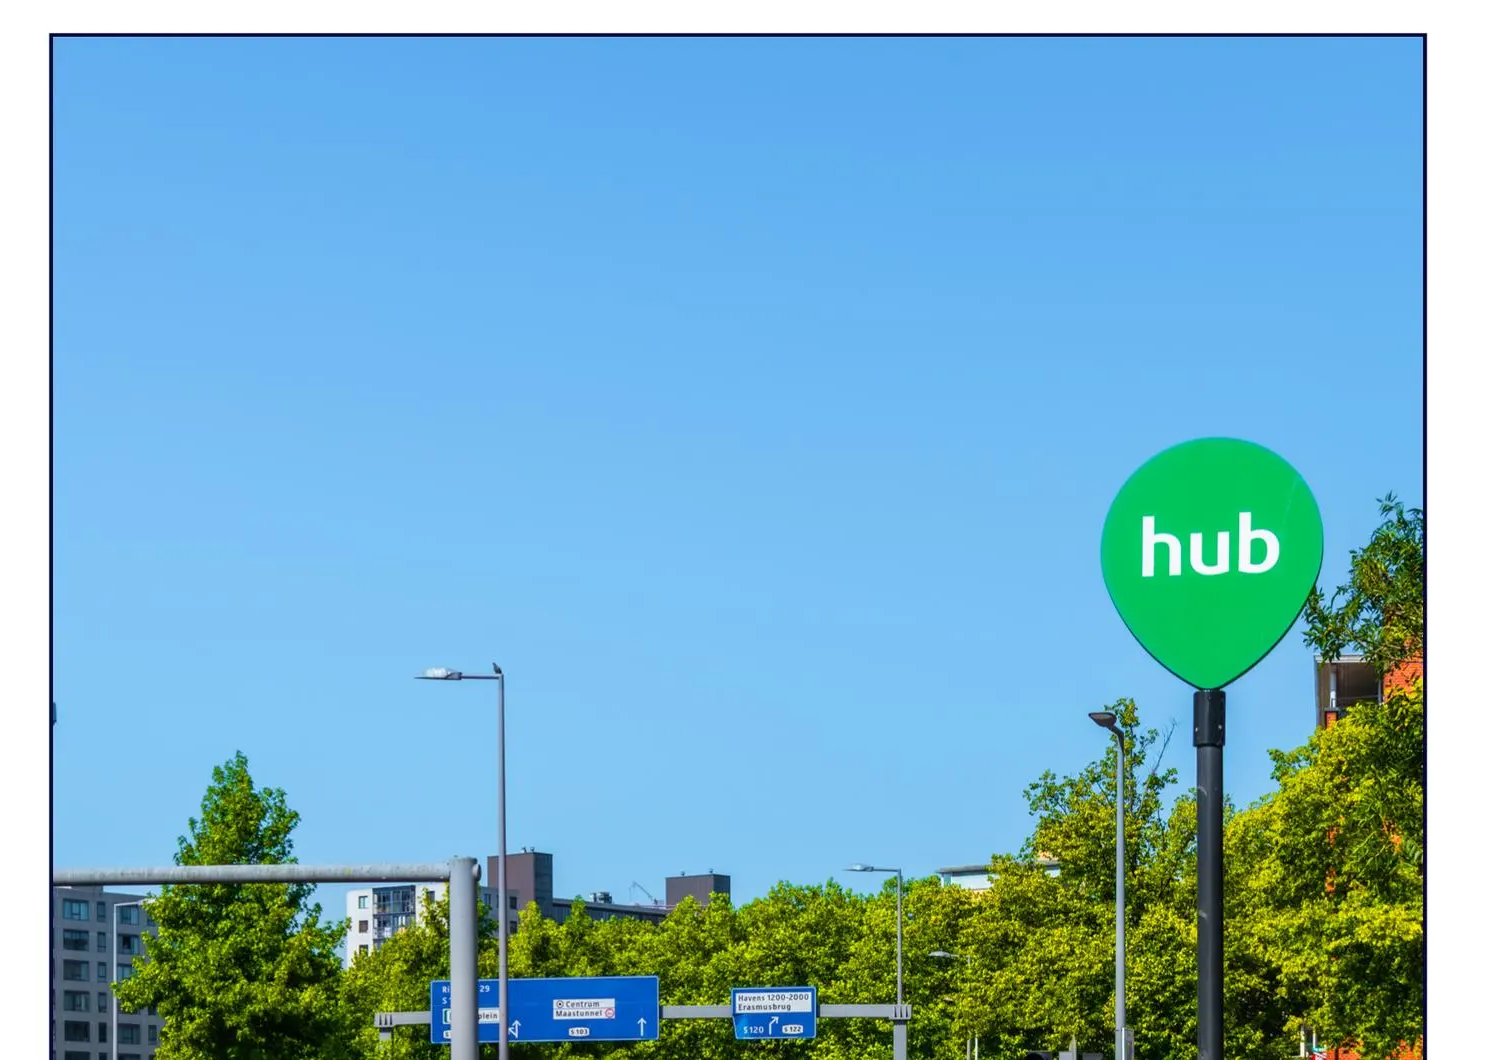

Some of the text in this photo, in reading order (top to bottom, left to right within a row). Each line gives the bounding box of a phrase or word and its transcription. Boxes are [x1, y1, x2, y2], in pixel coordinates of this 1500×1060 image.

[1142, 512, 1280, 577] hub
[767, 993, 809, 1001] 1200-2000
[738, 1003, 791, 1011] Erasmusbrug
[555, 1009, 603, 1017] Maastunnel
